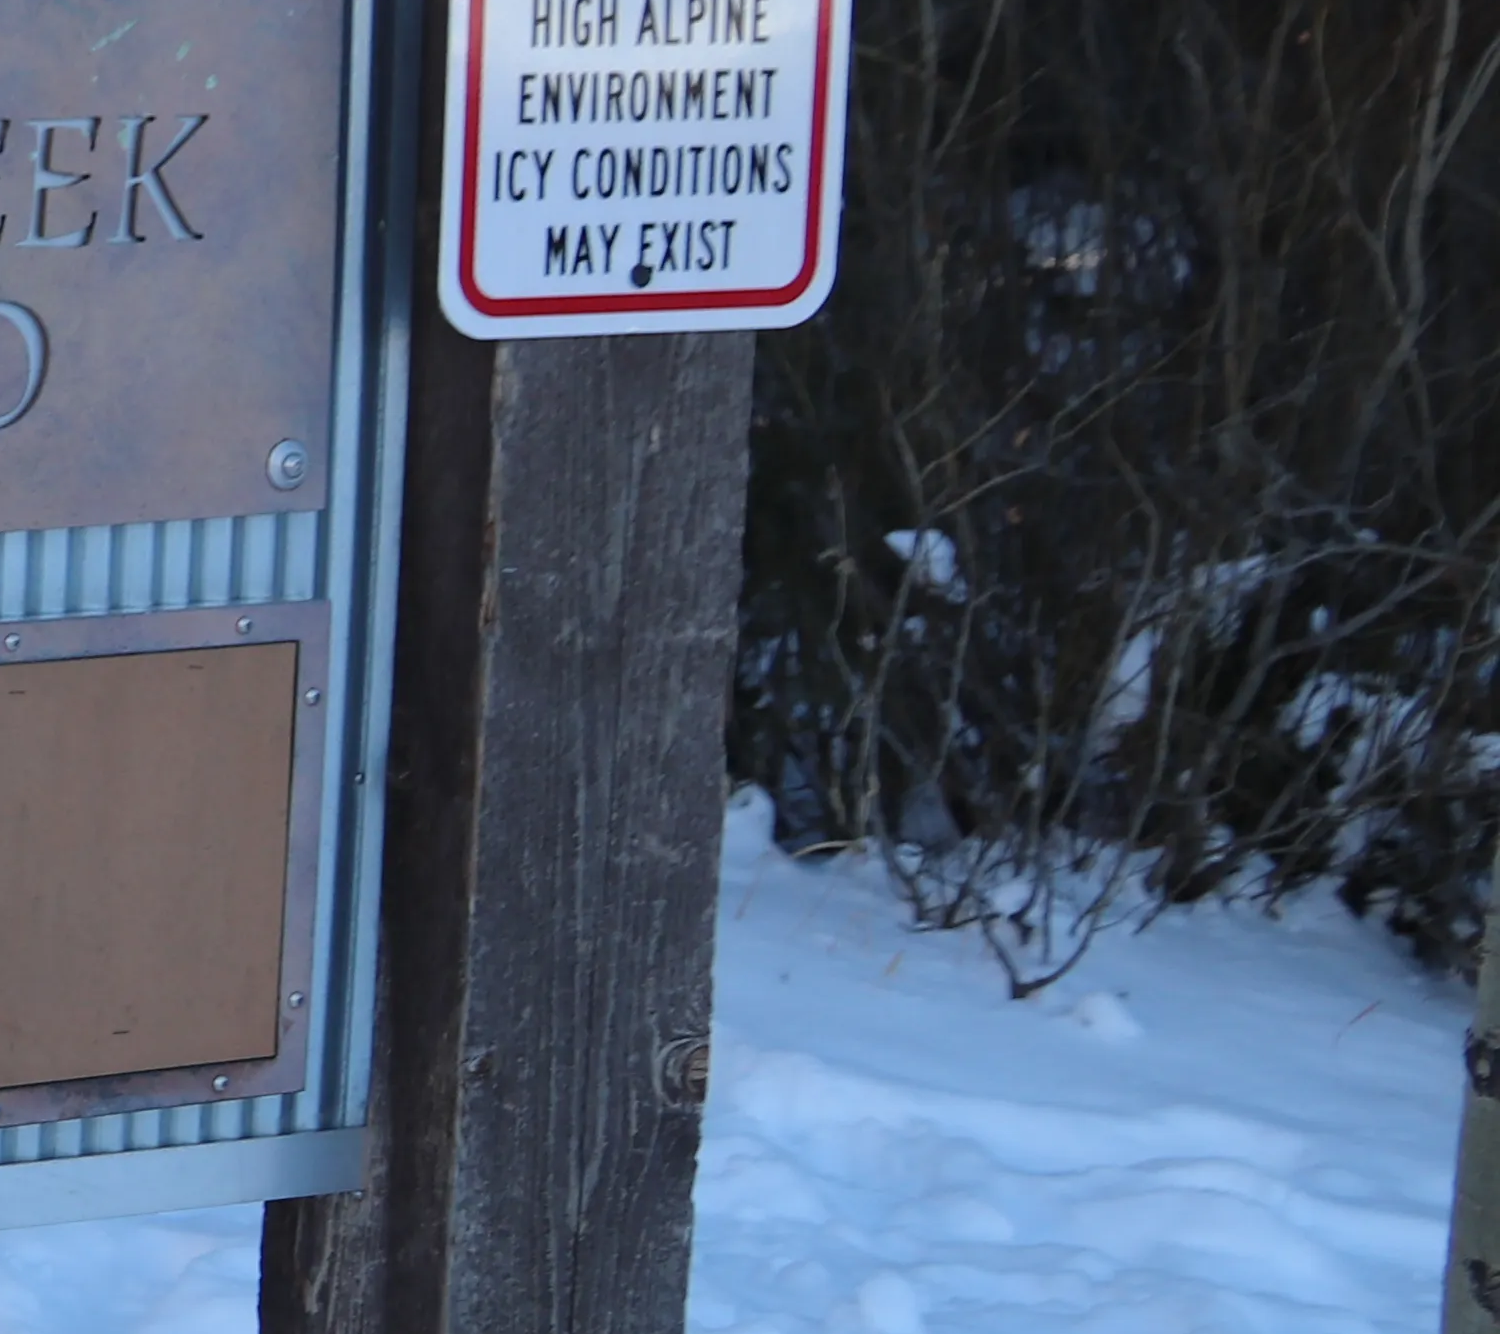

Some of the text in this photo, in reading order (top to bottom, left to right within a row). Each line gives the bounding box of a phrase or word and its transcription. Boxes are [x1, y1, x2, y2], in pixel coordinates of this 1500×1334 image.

[518, 69, 778, 125] ENVIRONMENT
[493, 143, 794, 202] ICY CONDITIONS
[544, 220, 736, 276] MAY EXIST
